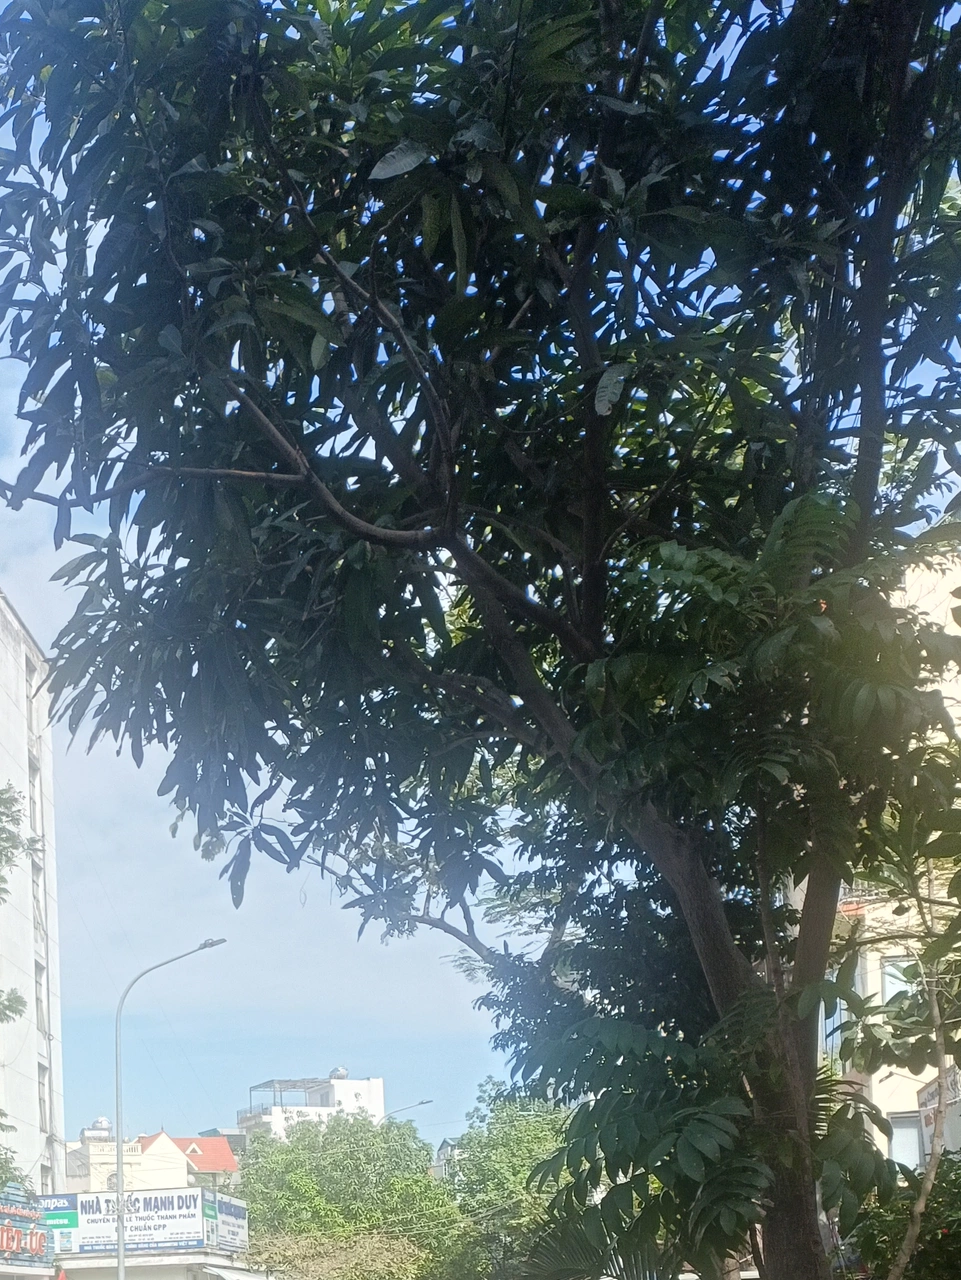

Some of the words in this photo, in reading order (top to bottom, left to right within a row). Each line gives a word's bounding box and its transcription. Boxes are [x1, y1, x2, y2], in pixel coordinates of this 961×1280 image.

[80, 1195, 102, 1216] NHÀ
[143, 1196, 175, 1215] MẠNH
[177, 1194, 199, 1210] DUY
[86, 1217, 110, 1225] CHUYÊN
[135, 1213, 155, 1222] THUỐC
[129, 1221, 152, 1232] CHUẨN
